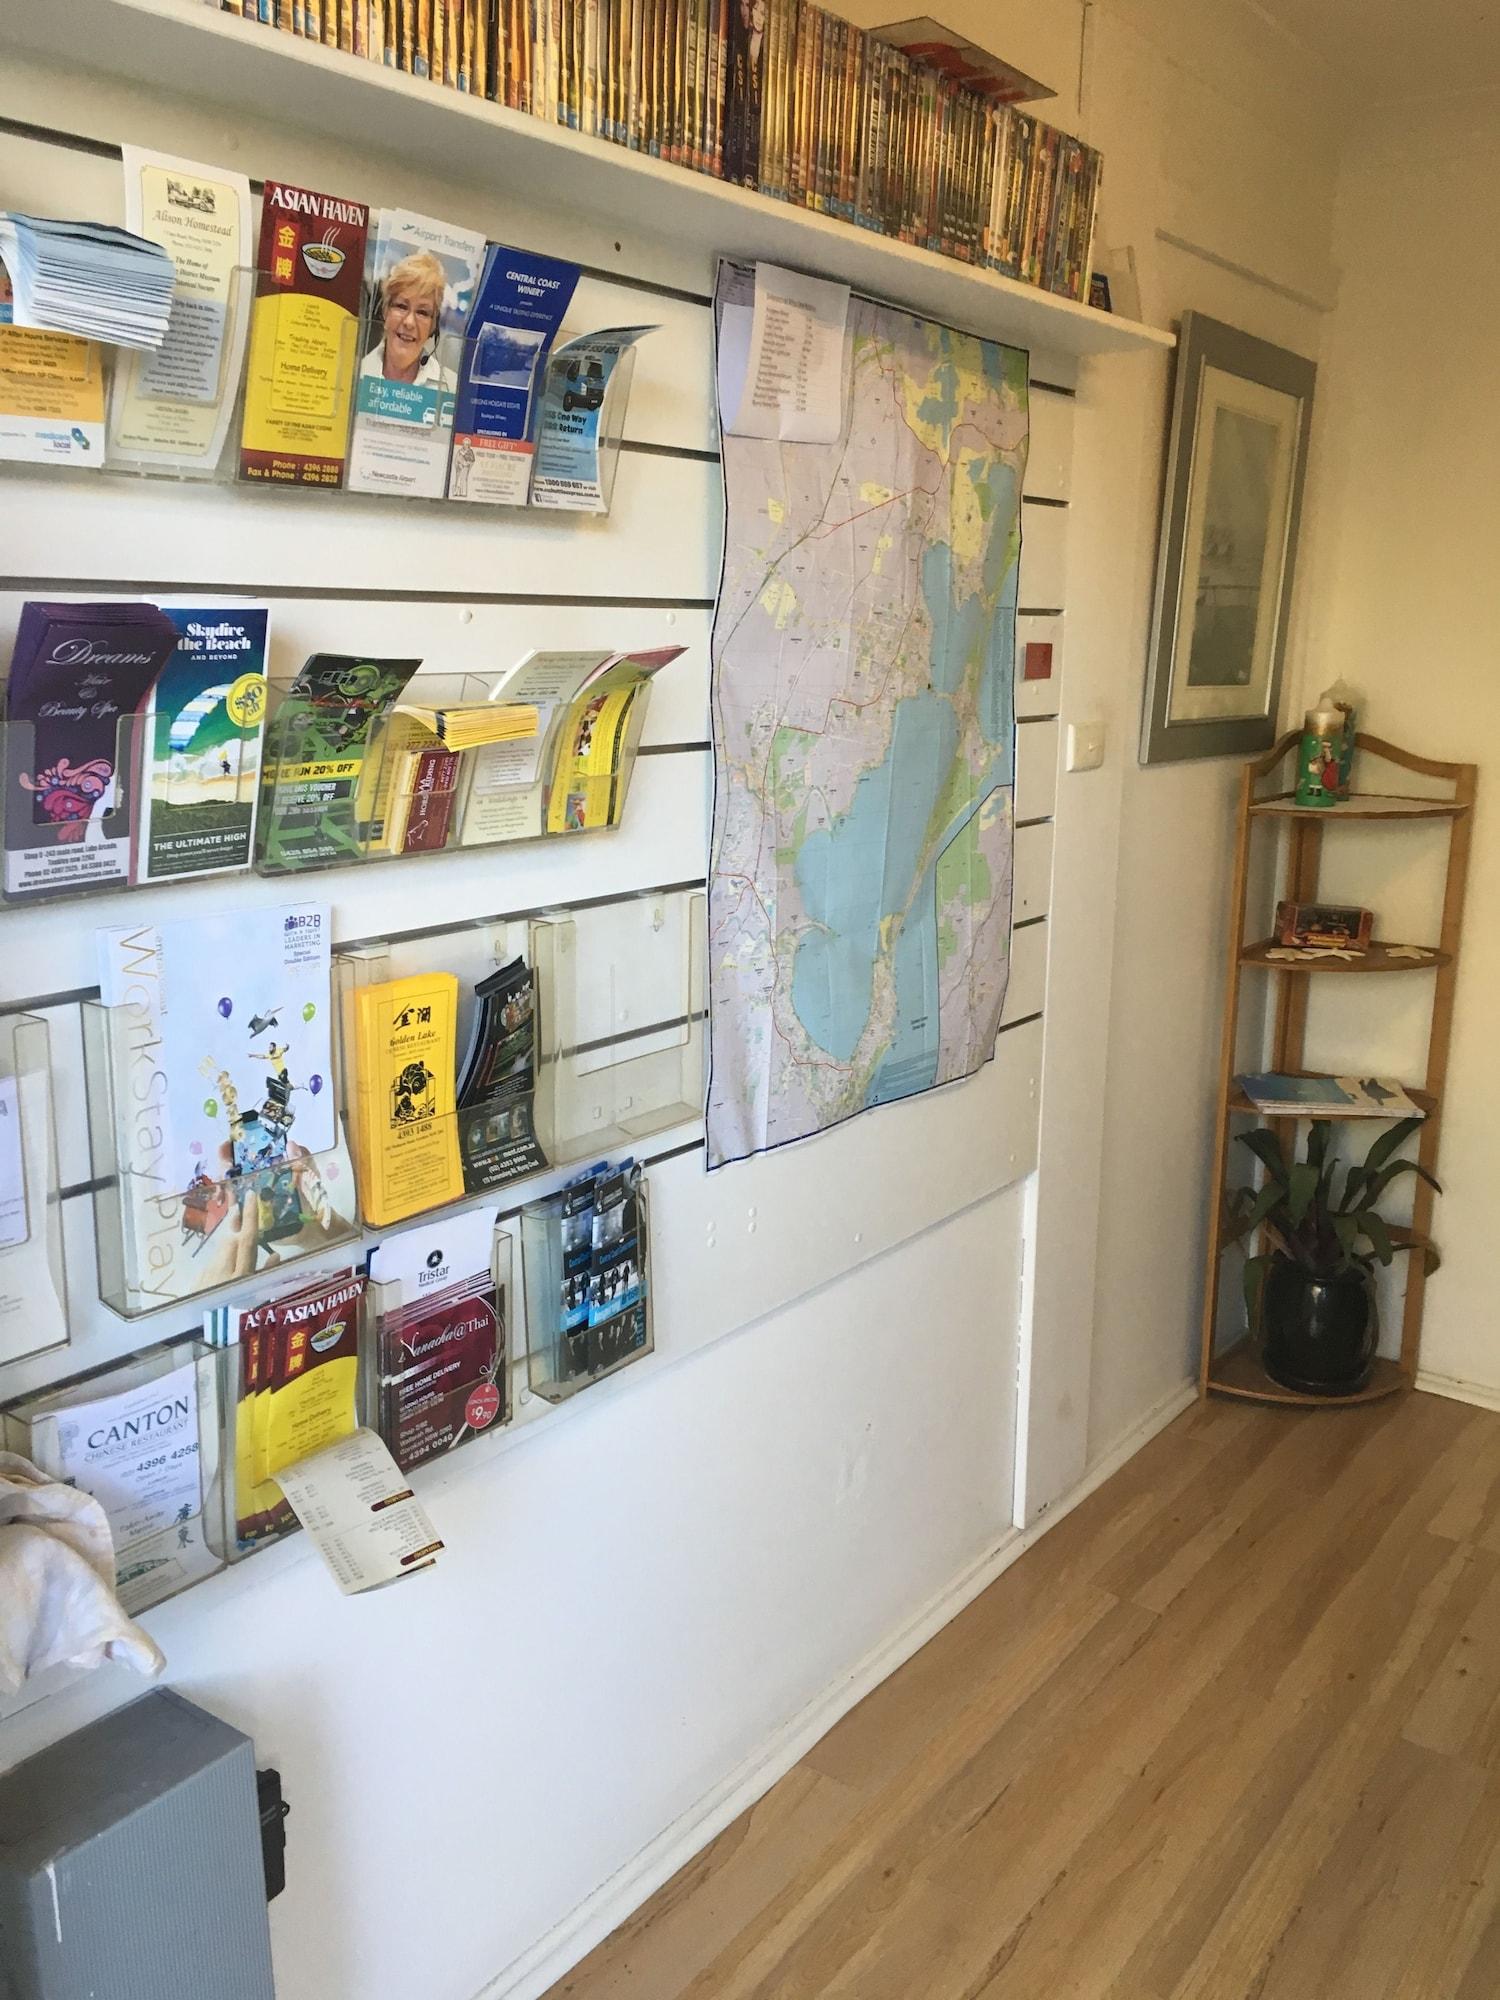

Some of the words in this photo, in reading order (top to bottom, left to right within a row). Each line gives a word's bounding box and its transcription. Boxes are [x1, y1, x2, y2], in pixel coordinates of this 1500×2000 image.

[270, 186, 321, 216] ASIAN
[322, 198, 365, 227] HAVEN
[152, 209, 182, 227] Alison
[184, 216, 235, 237] Homestead
[413, 227, 442, 244] Airport
[443, 235, 476, 253] Transfers
[506, 270, 537, 285] CENTRAL
[538, 276, 561, 290] COAST
[517, 284, 546, 298] WINERY
[280, 361, 300, 372] Home
[301, 364, 328, 377] Delivery
[369, 382, 389, 398] Easy,
[391, 388, 424, 403] reliable
[367, 398, 413, 415] affordable
[558, 411, 570, 420] One
[571, 414, 587, 426] Way
[559, 424, 584, 434] Return
[53, 440, 71, 449] local
[479, 439, 497, 448] FREE
[247, 466, 262, 476] Fax
[264, 468, 270, 478] &
[271, 469, 295, 480] Phone
[272, 460, 296, 470] Phone
[372, 470, 398, 480] Newcastle
[187, 622, 245, 638] Skydive
[45, 638, 156, 665] Dreams
[177, 638, 202, 651] the
[206, 637, 251, 650] Beach
[38, 701, 87, 721] Beauty
[91, 701, 119, 719] Spa
[313, 765, 334, 775] 20%
[337, 763, 355, 773] OFF
[322, 793, 336, 801] OFF
[153, 841, 173, 851] THE
[175, 835, 222, 849] ULTIMATE
[224, 832, 247, 842] HIGH
[299, 914, 321, 928] B2B
[284, 934, 312, 944] LEADERS
[284, 940, 321, 950] MARKETING
[390, 1034, 415, 1046] Golden
[418, 1030, 436, 1040] Lake
[418, 1266, 450, 1283] Tristar
[283, 1300, 325, 1326] ASIAN
[326, 1281, 364, 1310] HAVEN
[415, 1374, 433, 1388] HOME
[433, 1361, 461, 1379] DELIVERY
[87, 1395, 188, 1449] CANTON
[131, 1418, 188, 1447] RESTAURANT
[432, 1433, 453, 1449] 0040
[136, 1455, 166, 1471] 4396
